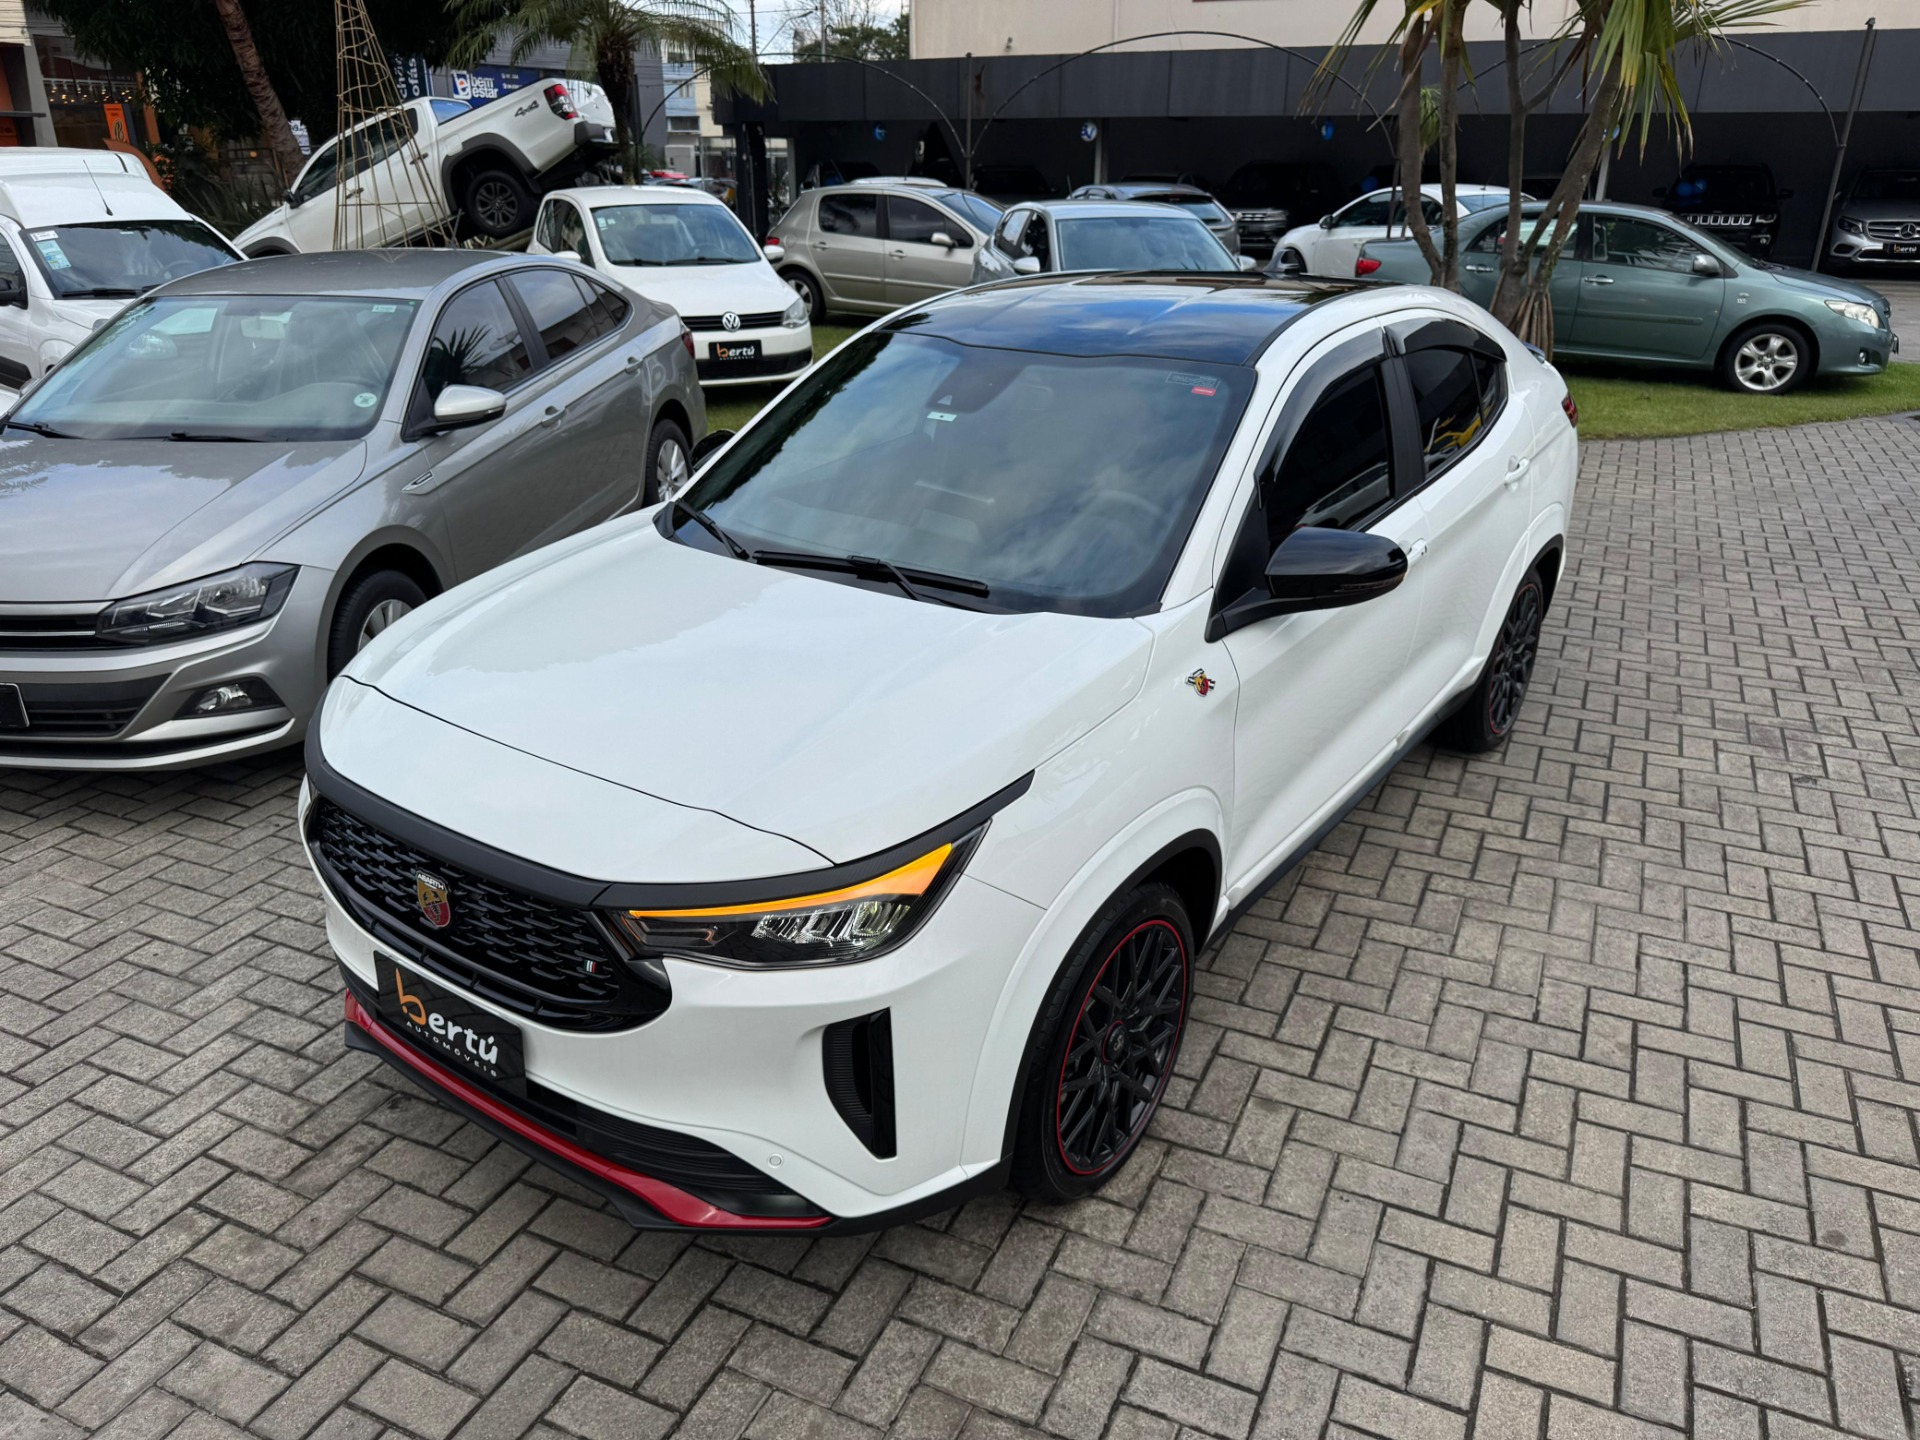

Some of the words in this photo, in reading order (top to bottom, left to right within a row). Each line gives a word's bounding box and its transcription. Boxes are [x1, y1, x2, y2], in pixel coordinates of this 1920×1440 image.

[470, 73, 494, 88] bem
[472, 87, 499, 98] estar
[716, 342, 755, 358] bertú
[395, 967, 498, 1064] bertú
